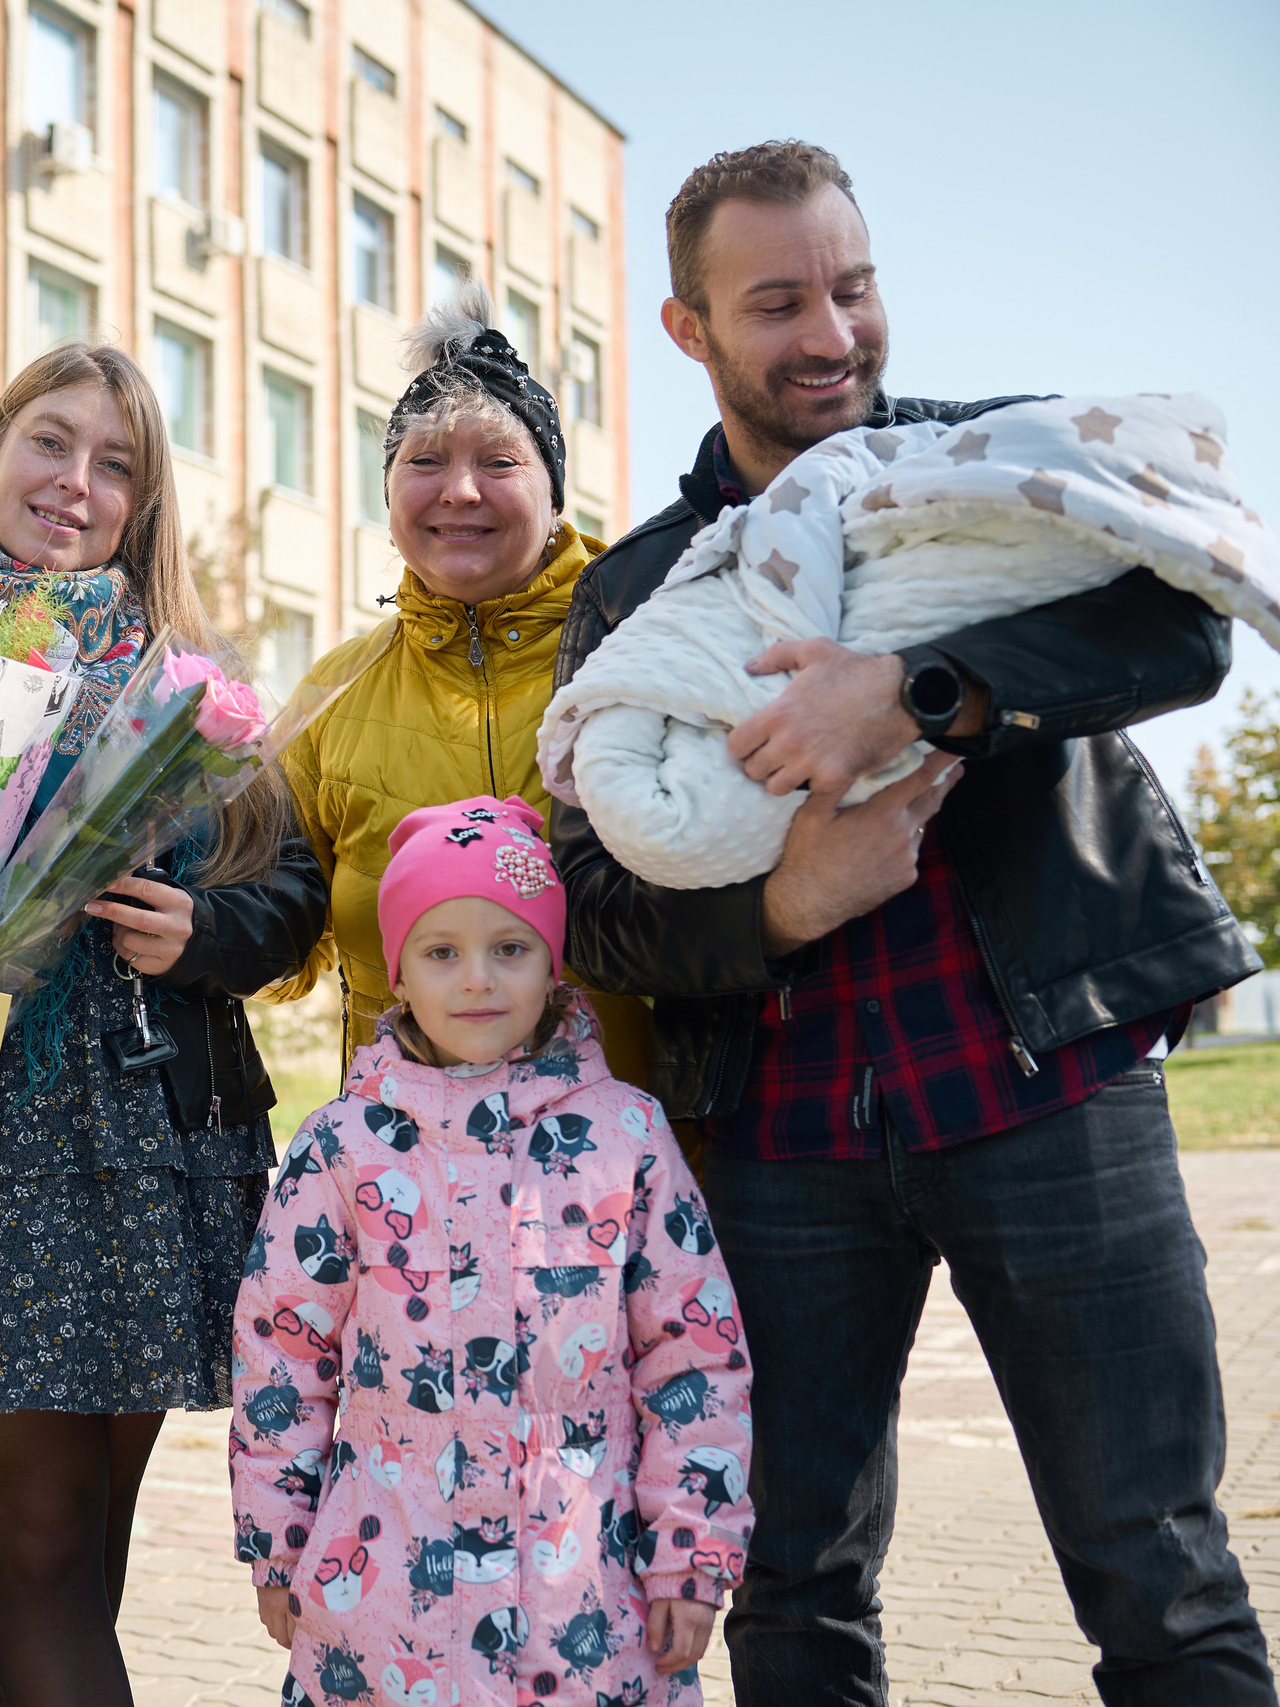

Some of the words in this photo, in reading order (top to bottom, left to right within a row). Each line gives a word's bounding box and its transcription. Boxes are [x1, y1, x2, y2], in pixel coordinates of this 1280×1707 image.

[447, 827, 482, 842] Love
[661, 1387, 697, 1412] Hello
[257, 1401, 289, 1421] Hello
[426, 1554, 453, 1575] Hell
[575, 1628, 601, 1657] Hello
[330, 1662, 353, 1681] Hello
